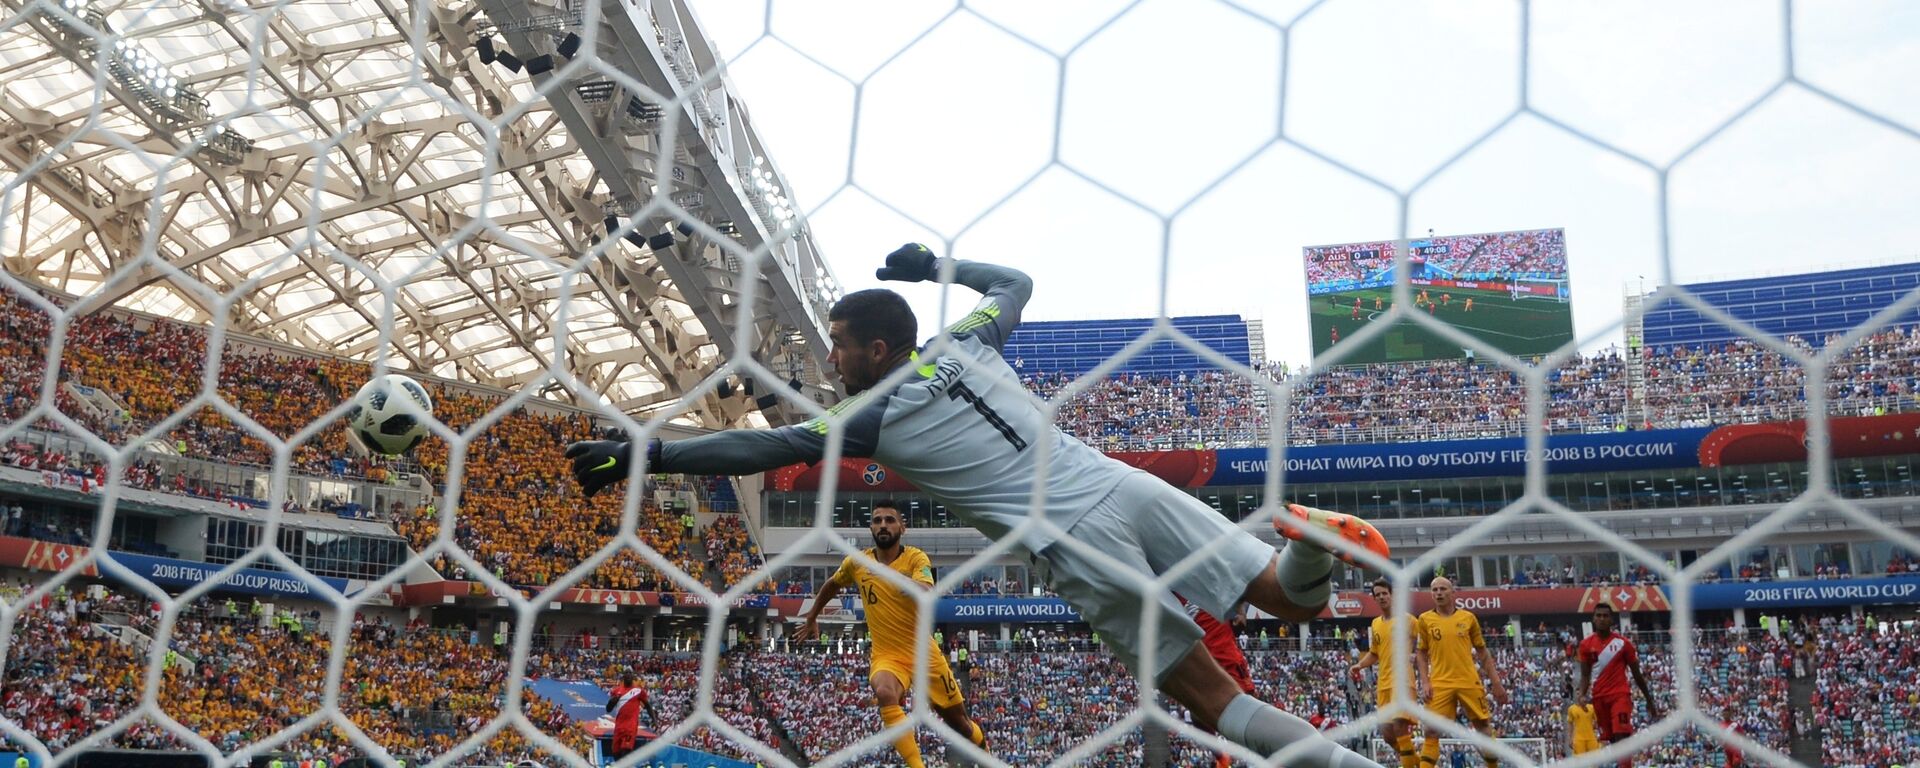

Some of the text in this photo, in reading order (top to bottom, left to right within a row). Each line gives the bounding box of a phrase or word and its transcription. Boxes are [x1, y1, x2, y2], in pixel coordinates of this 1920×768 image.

[1327, 252, 1347, 261] AUS
[1354, 252, 1361, 260] 0
[1369, 251, 1374, 259] 1
[947, 380, 1028, 452] 1
[1335, 455, 1386, 470] МИРА
[1388, 454, 1414, 468] ПО
[1417, 450, 1496, 467] ФУТБОЛУ
[1542, 447, 1580, 462] 2018
[1583, 446, 1597, 459] В
[1600, 442, 1674, 458] РОССИИ
[152, 563, 179, 579] 2018
[180, 566, 203, 582] FIFA
[245, 574, 269, 589] CUP
[269, 577, 309, 594] RUSSIA
[861, 585, 878, 605] 16
[1744, 583, 1917, 602] 2018 FIFA WORLD CUP
[955, 605, 985, 616] 2018
[987, 604, 1016, 616] FIFA
[1017, 604, 1066, 616] WORLD
[1455, 596, 1501, 609] SOCHI
[1430, 628, 1442, 641] 13
[940, 670, 956, 694] 16
